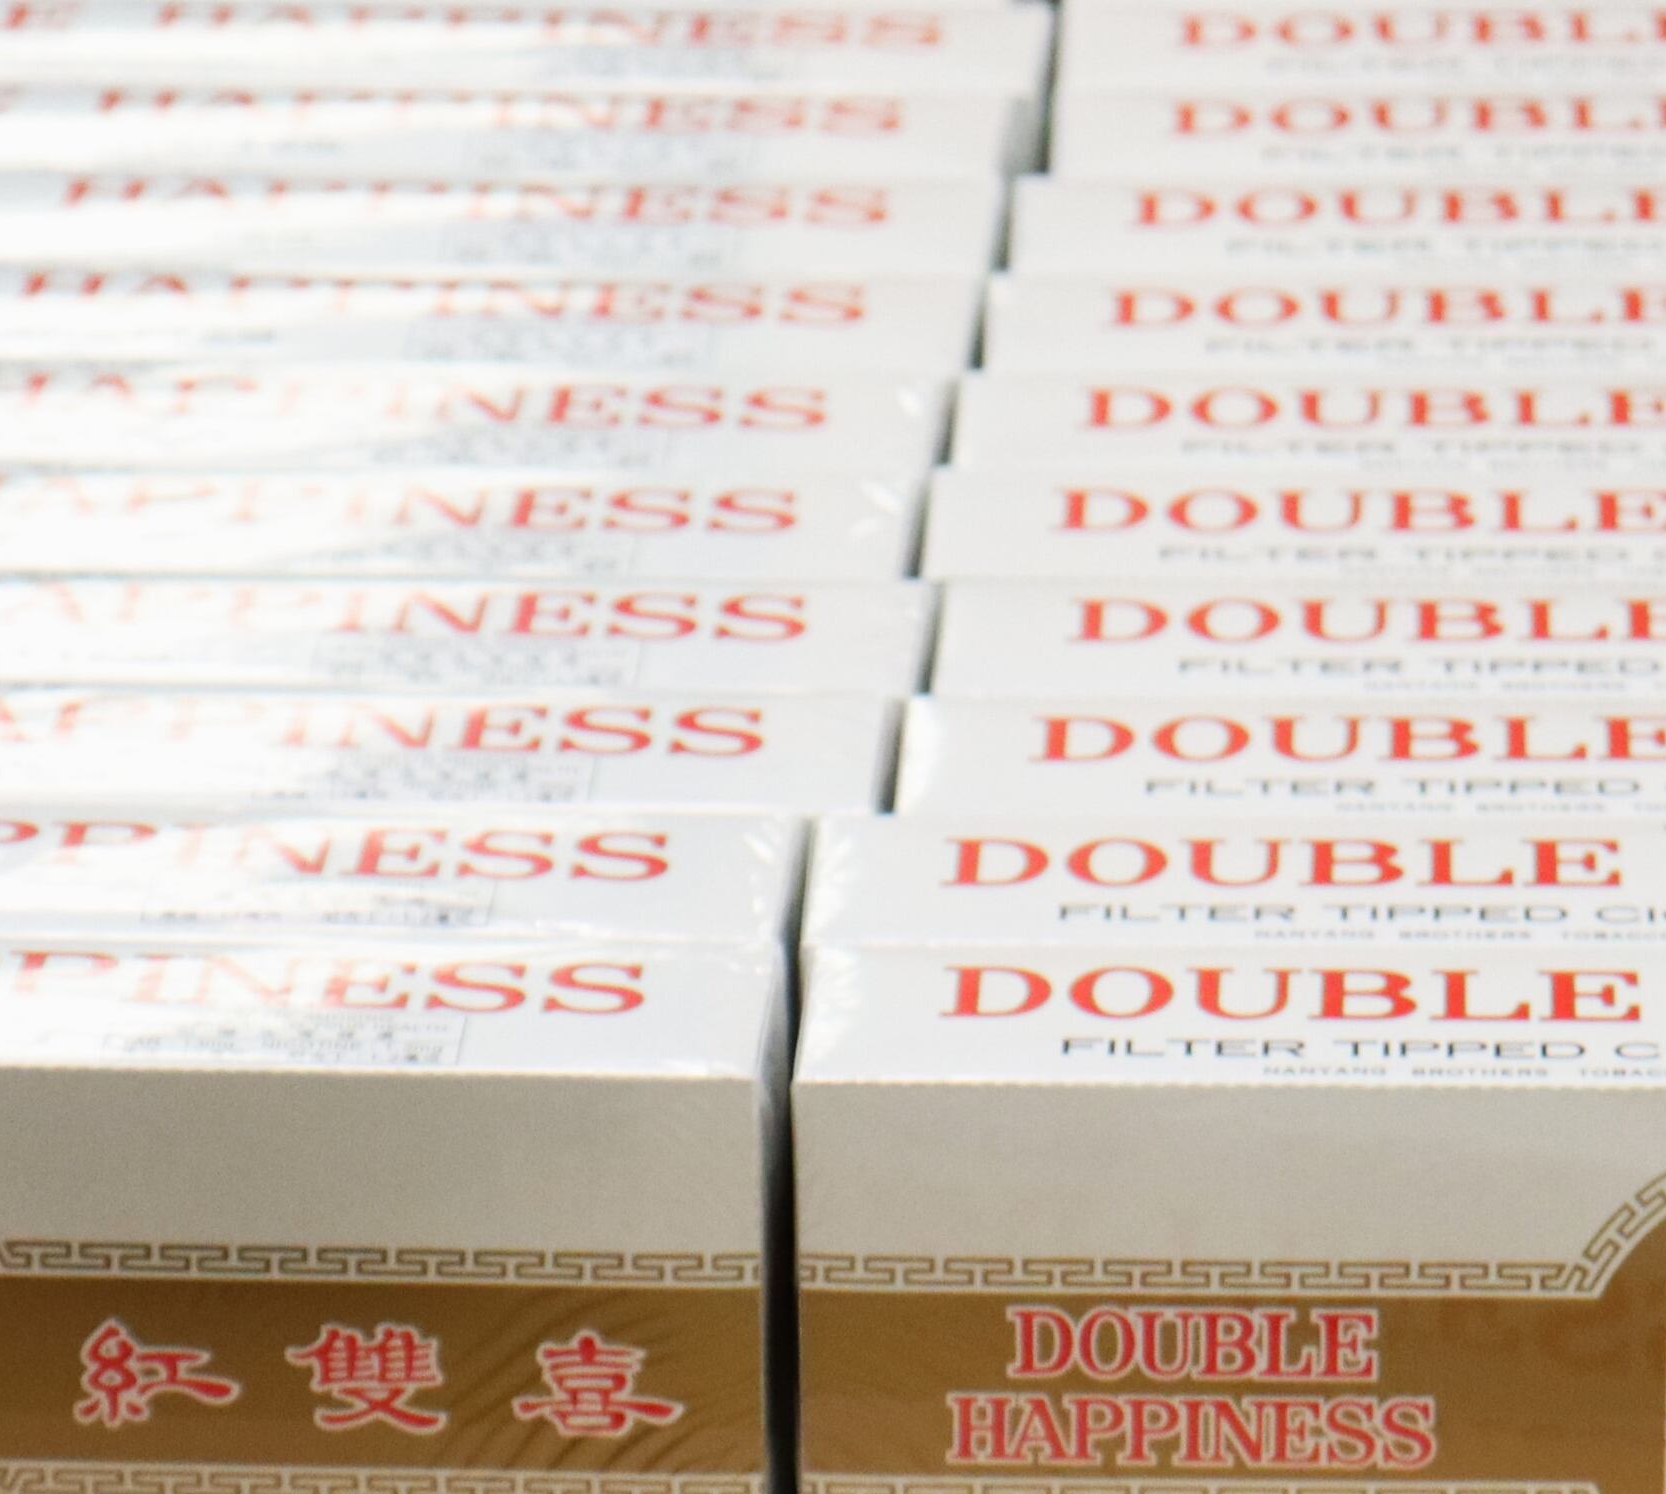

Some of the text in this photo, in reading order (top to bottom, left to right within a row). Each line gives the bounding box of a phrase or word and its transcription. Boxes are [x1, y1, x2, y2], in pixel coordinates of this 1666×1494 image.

[1178, 659, 1402, 675] FILTER
[1428, 660, 1660, 676] TIPPED
[1145, 780, 1375, 796] FILTER
[1400, 780, 1641, 796] TIPPED
[943, 834, 1624, 888] DOUBLE
[1059, 906, 1295, 922] FILTER
[1322, 906, 1568, 922] TIPPED
[941, 962, 1644, 1023] DOUBLE
[1062, 1039, 1305, 1057] FILTER
[1333, 1041, 1586, 1059] TIPPED
[1006, 1303, 1379, 1382] DOUBLE
[73, 1316, 686, 1438] 紅雙喜
[945, 1391, 1436, 1471] HAPPINESS
